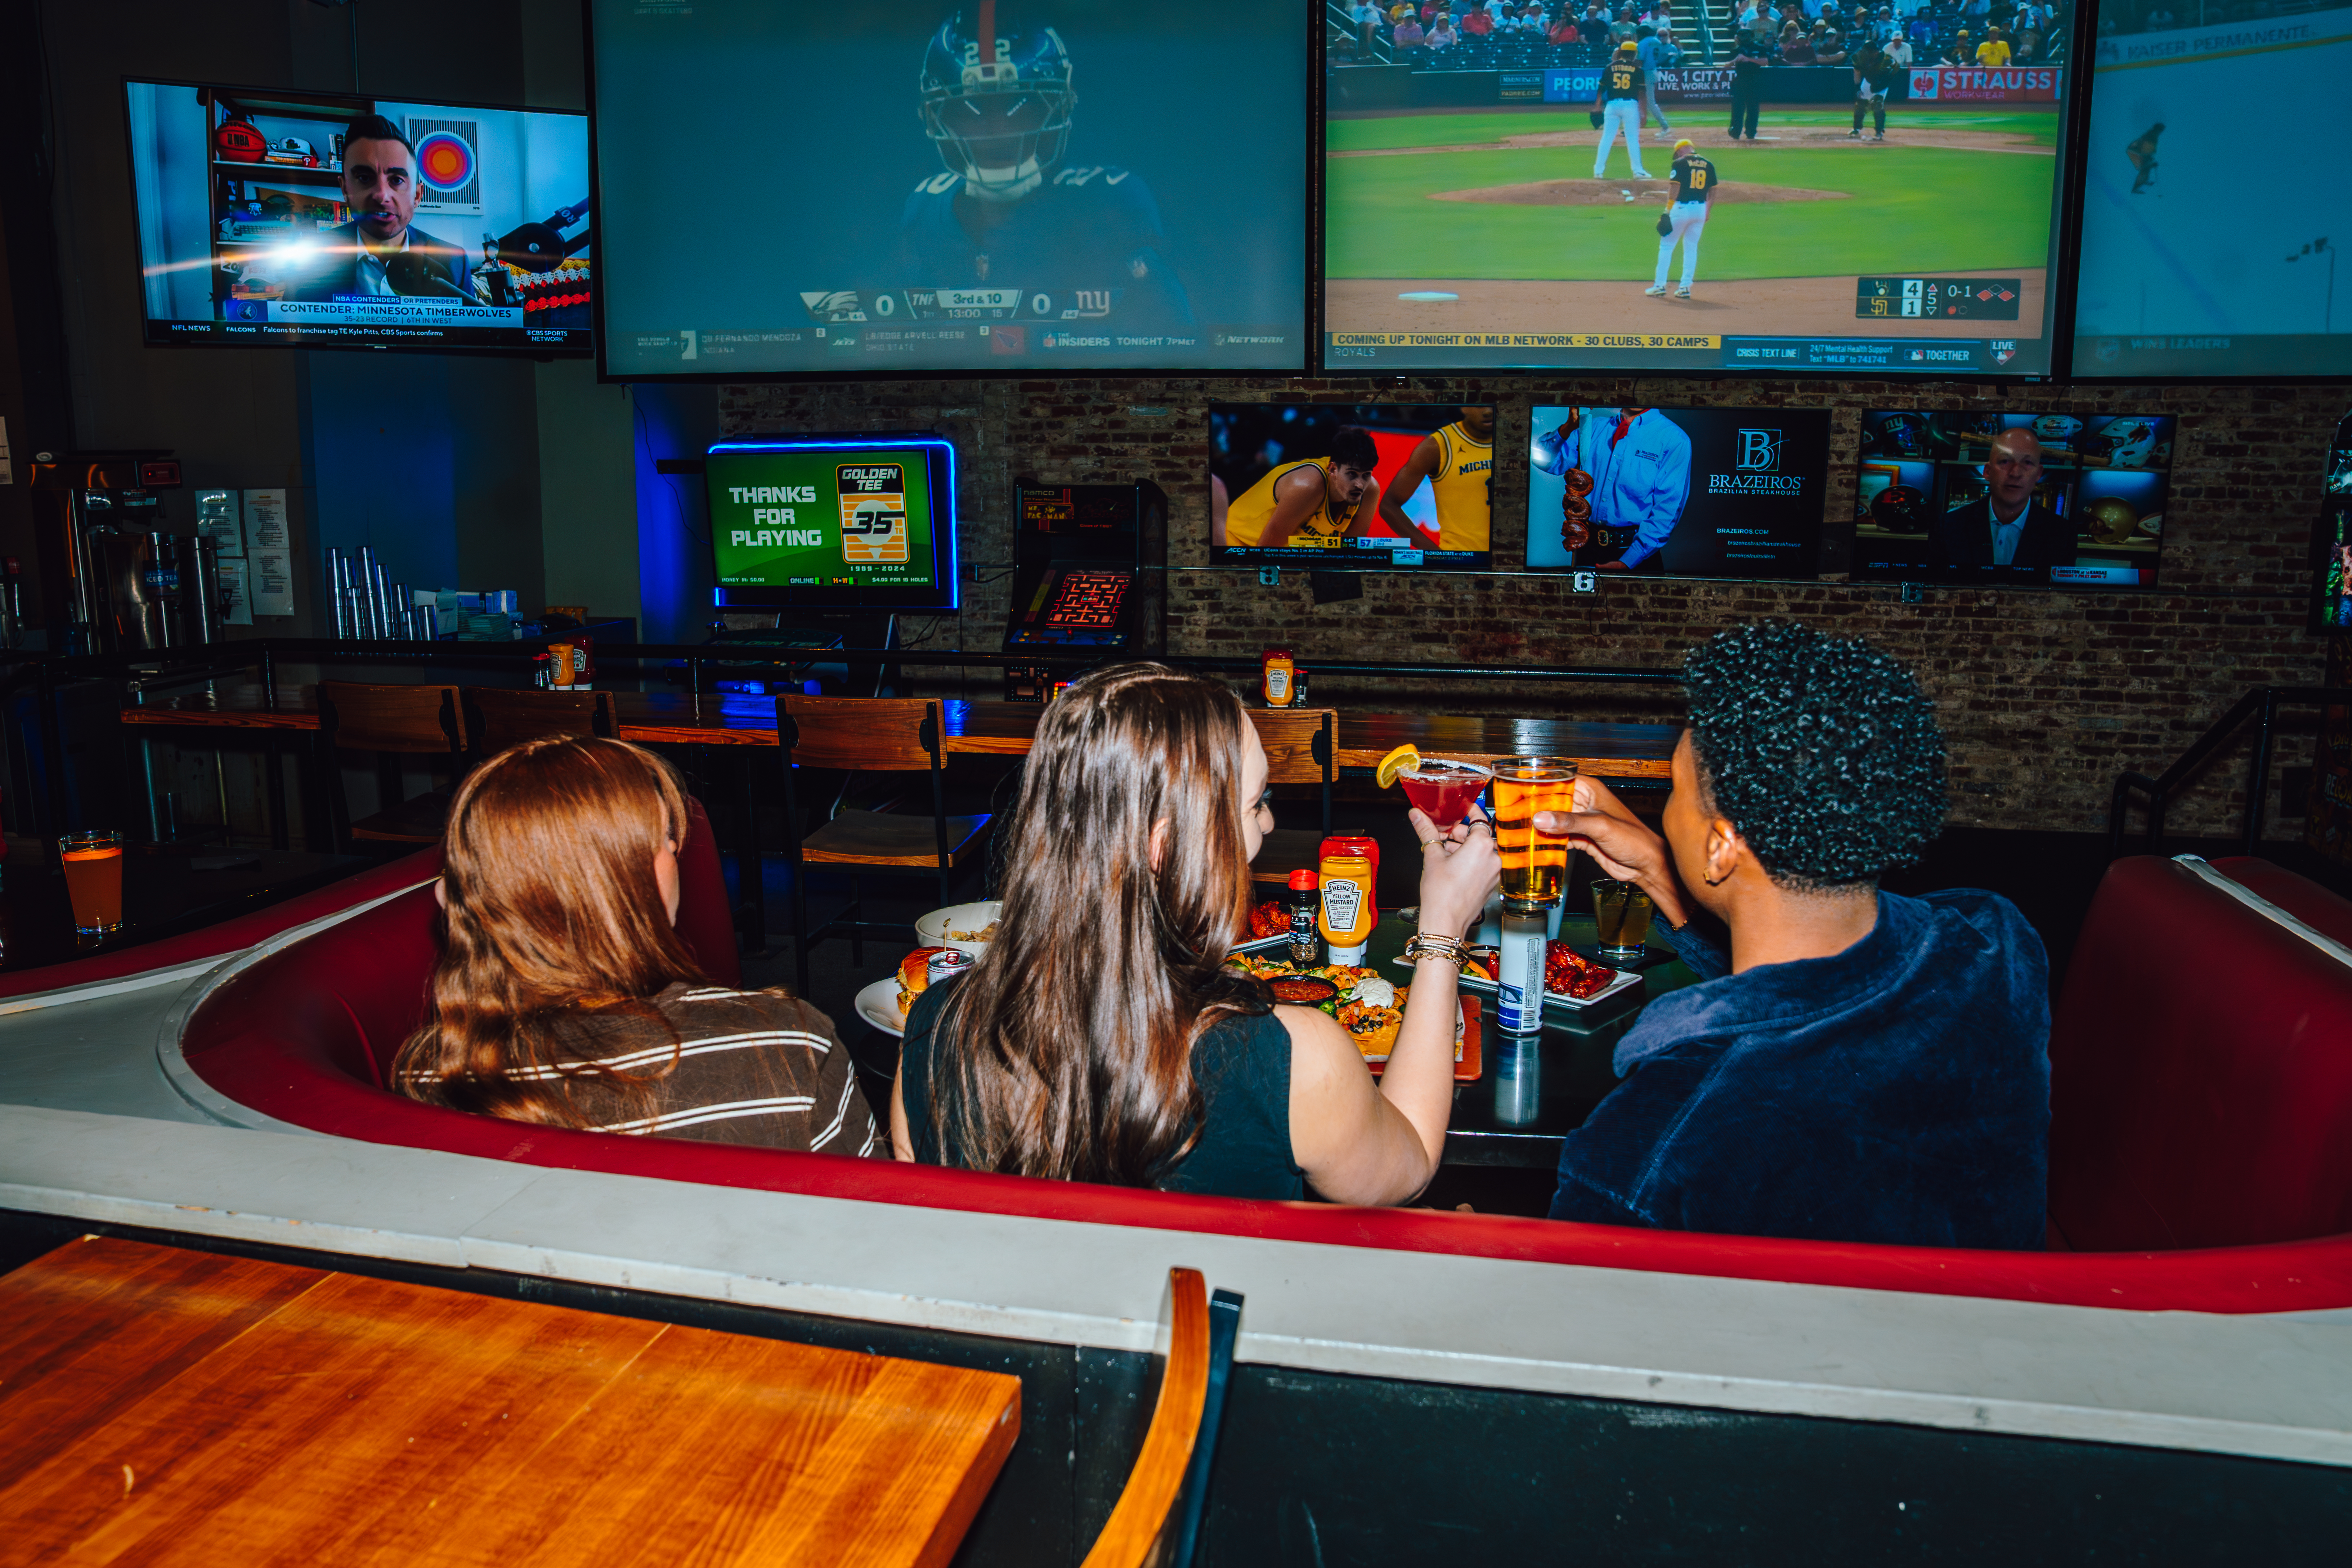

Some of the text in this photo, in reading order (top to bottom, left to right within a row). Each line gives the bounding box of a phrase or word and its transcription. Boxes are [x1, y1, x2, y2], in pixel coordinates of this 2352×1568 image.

[2128, 25, 2311, 60] KAISER PERMANENTE
[1613, 73, 1631, 89] 56
[1683, 71, 1688, 82] 1
[1692, 71, 1722, 82] CITY
[1944, 71, 2051, 89] STRAUSS
[1681, 82, 1710, 90] WORK
[1944, 90, 2004, 99] WORKWEAR
[235, 134, 249, 147] NBA
[1689, 169, 1706, 189] 18
[1908, 282, 1918, 296] 4
[1948, 285, 1971, 297] 0-1
[875, 295, 894, 316] 0
[913, 294, 935, 305] TNF
[953, 294, 975, 304] 3rd
[987, 294, 1002, 304] 10
[1032, 293, 1051, 314] 0
[1928, 294, 1936, 304] 5
[281, 304, 511, 318] CONTENDER: MINNESOTA TIMBERWOLVES
[948, 309, 1002, 318] 13:00 15
[1908, 301, 1916, 314] 1
[1058, 337, 1163, 347] INSIDERS TONIGHT
[1338, 335, 1709, 348] COMING UP TONIGHT ON MLB NETWORK 30 CLUBS, 30 CAMPS
[1334, 348, 1375, 357] ROYALS
[1762, 349, 1779, 357] TEXT
[1781, 349, 1797, 358] LINE
[1868, 345, 1893, 354] Support
[1926, 350, 1969, 360] TOGETHER
[842, 468, 898, 479] GOLDEN
[856, 480, 883, 490] TEE
[1709, 475, 1801, 489] BRAZEIROS
[729, 486, 816, 503] THANKS
[754, 508, 795, 524] FOR
[843, 511, 905, 534] 35
[731, 530, 821, 546] PLAYING
